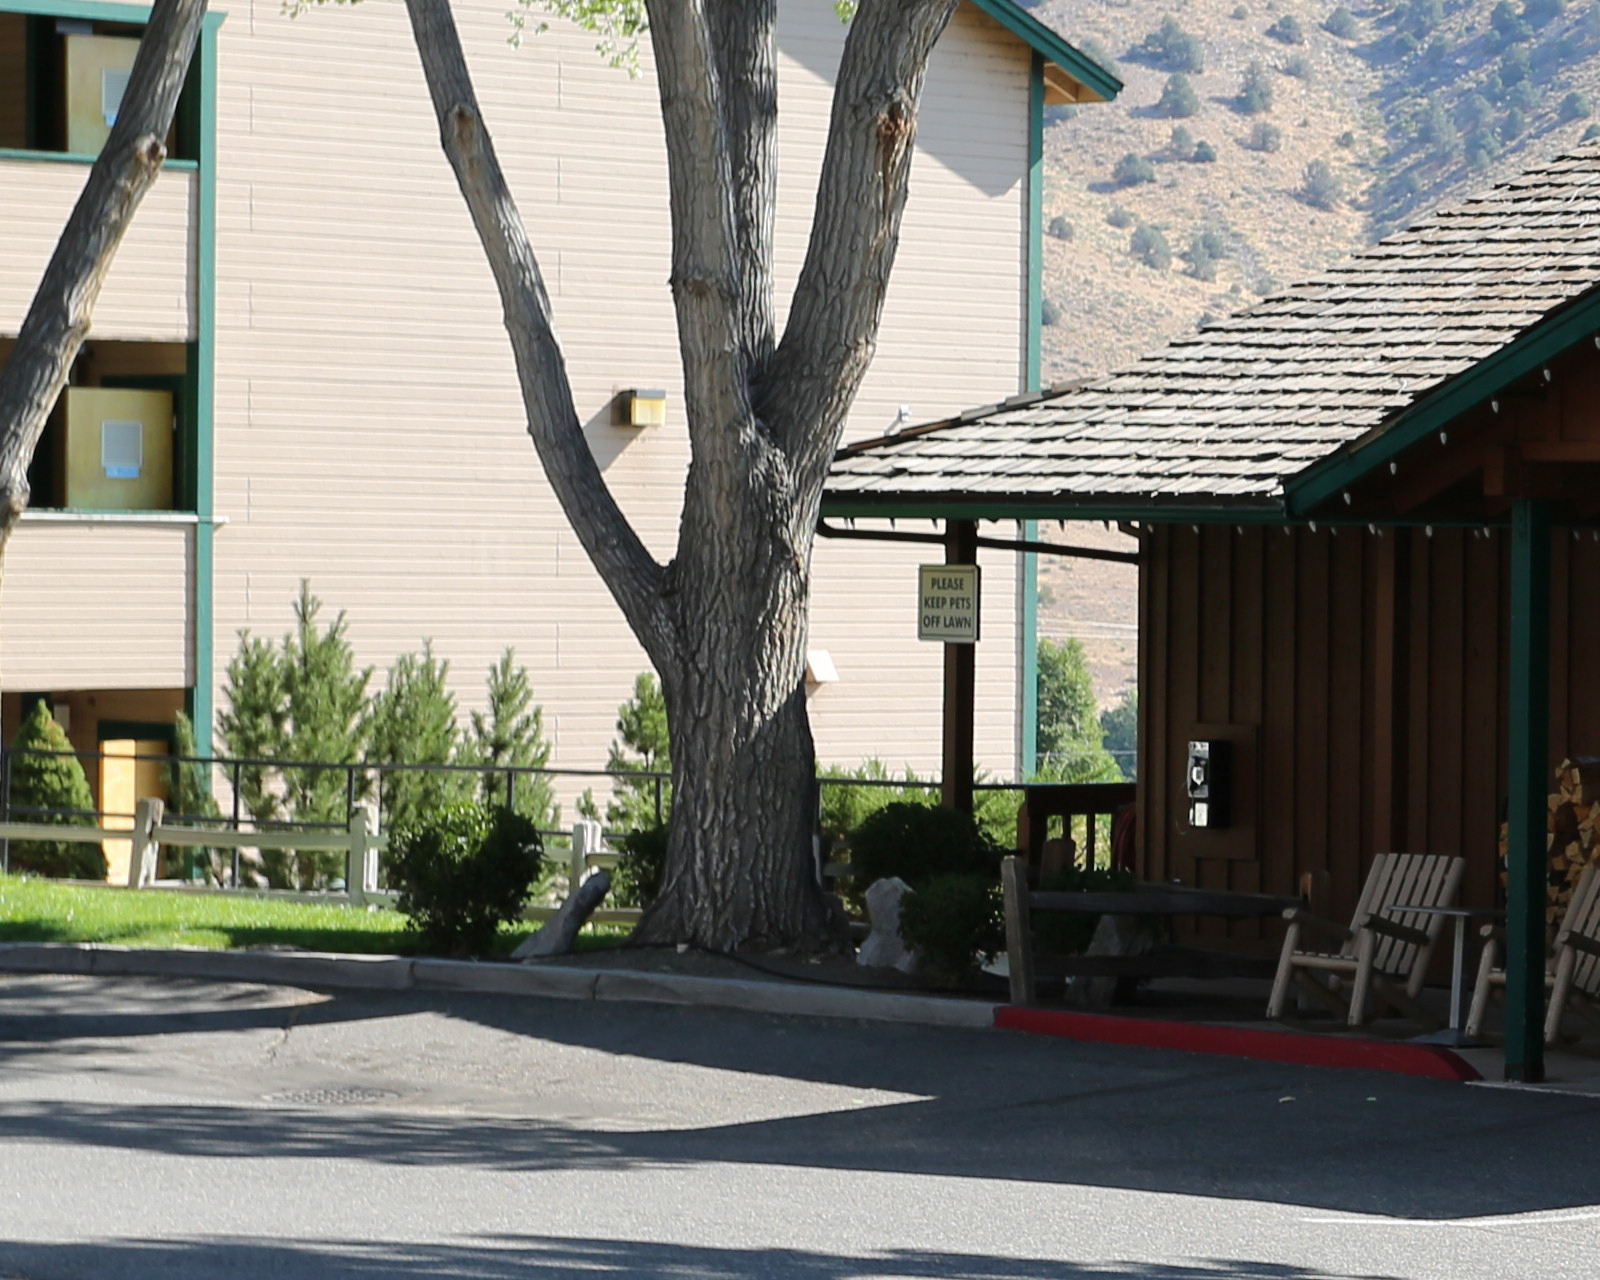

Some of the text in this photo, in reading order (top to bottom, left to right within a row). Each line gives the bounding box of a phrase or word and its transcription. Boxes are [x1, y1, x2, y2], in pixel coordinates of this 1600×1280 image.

[931, 577, 965, 590] PLEASE
[924, 596, 971, 610] KEEP PETS
[923, 615, 972, 629] OFF LAWN
